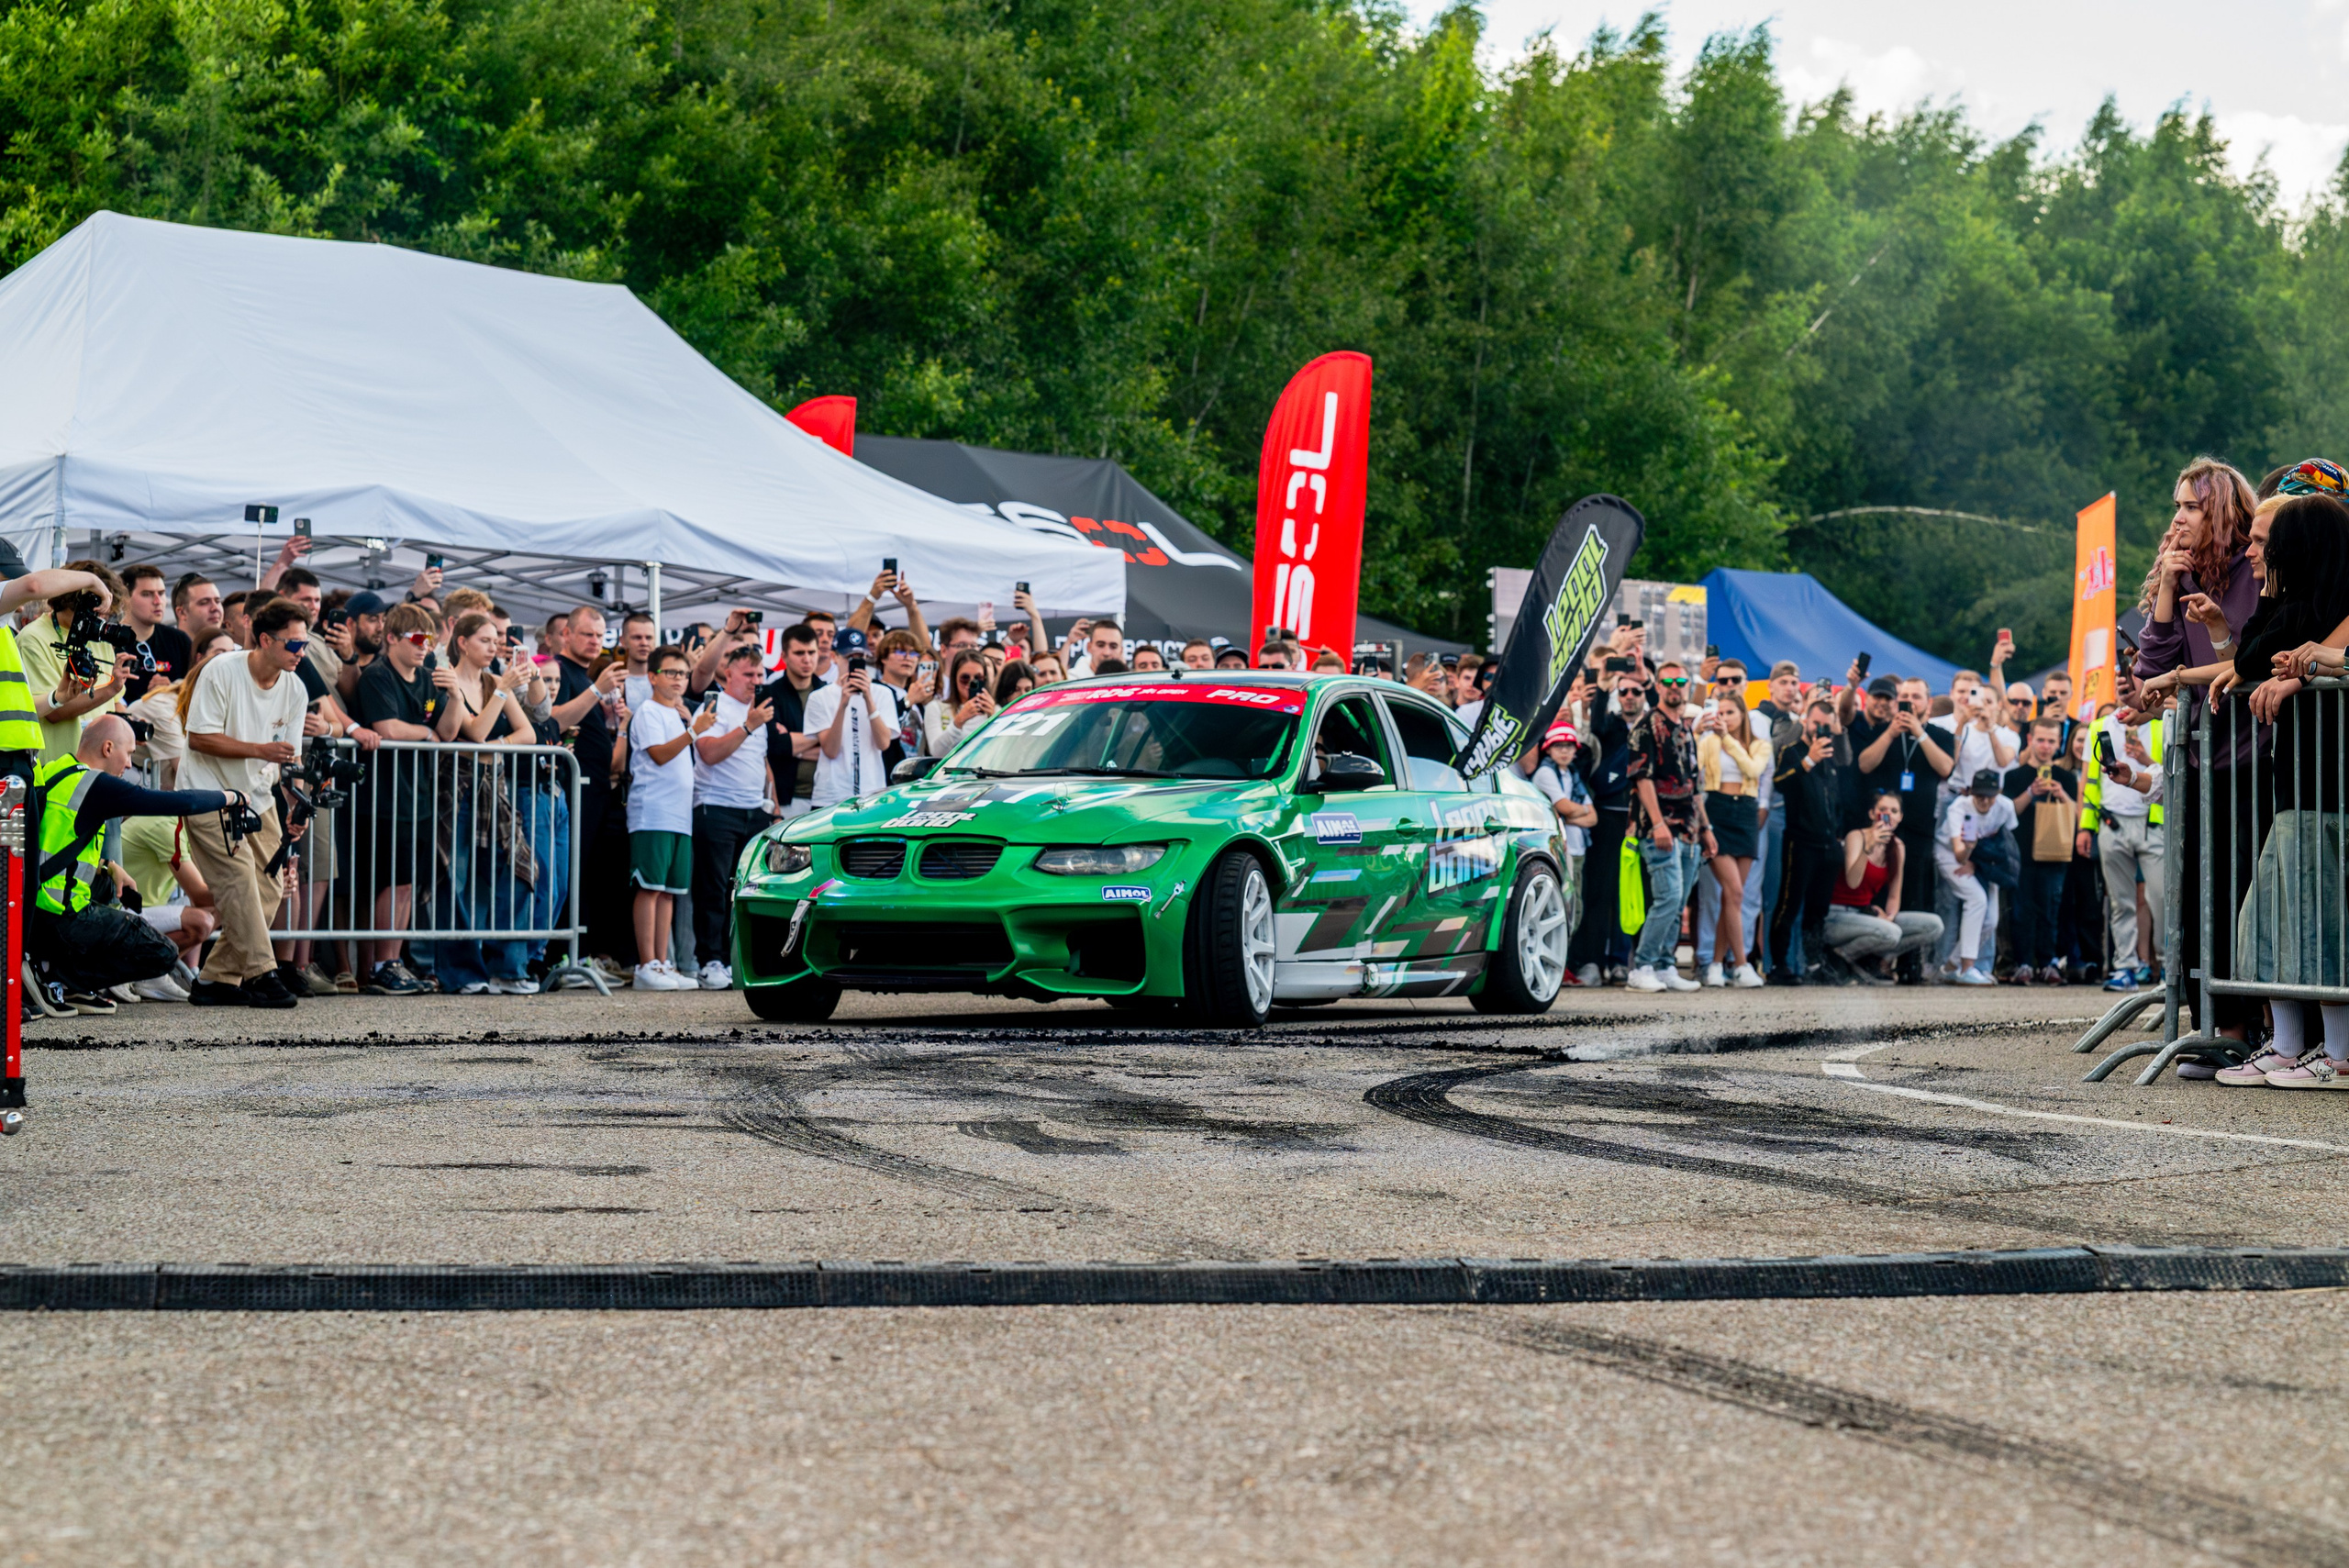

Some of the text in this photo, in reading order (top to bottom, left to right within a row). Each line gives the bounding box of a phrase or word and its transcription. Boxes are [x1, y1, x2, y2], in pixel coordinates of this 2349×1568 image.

[1206, 689, 1281, 704] PRO
[982, 712, 1071, 738] 121
[1316, 819, 1361, 837] AIMOL
[1105, 889, 1149, 899] AIMOL
